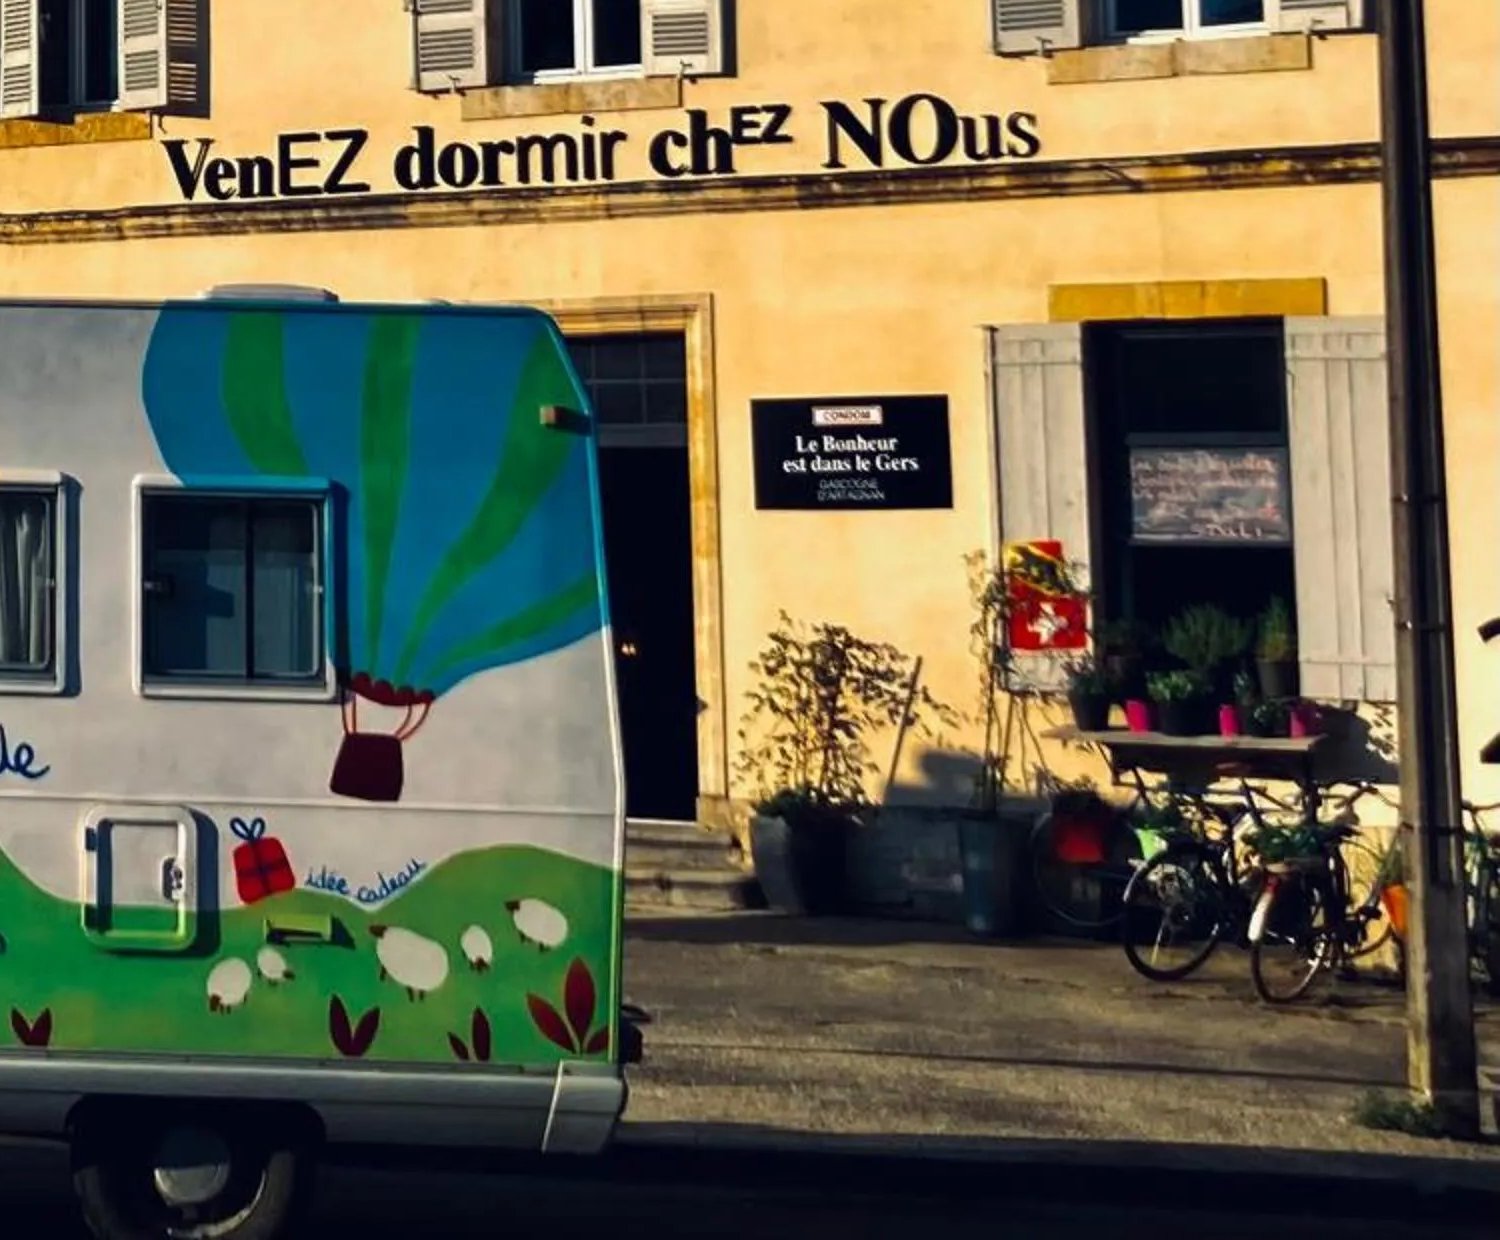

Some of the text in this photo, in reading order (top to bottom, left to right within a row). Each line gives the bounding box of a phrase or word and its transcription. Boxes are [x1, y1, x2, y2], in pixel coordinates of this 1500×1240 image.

[162, 93, 1041, 201] VenEZ dormir chEZ NOus
[795, 434, 899, 453] Le Bonheur
[782, 453, 920, 473] est dans le Gers
[304, 856, 426, 903] idée cadeau
